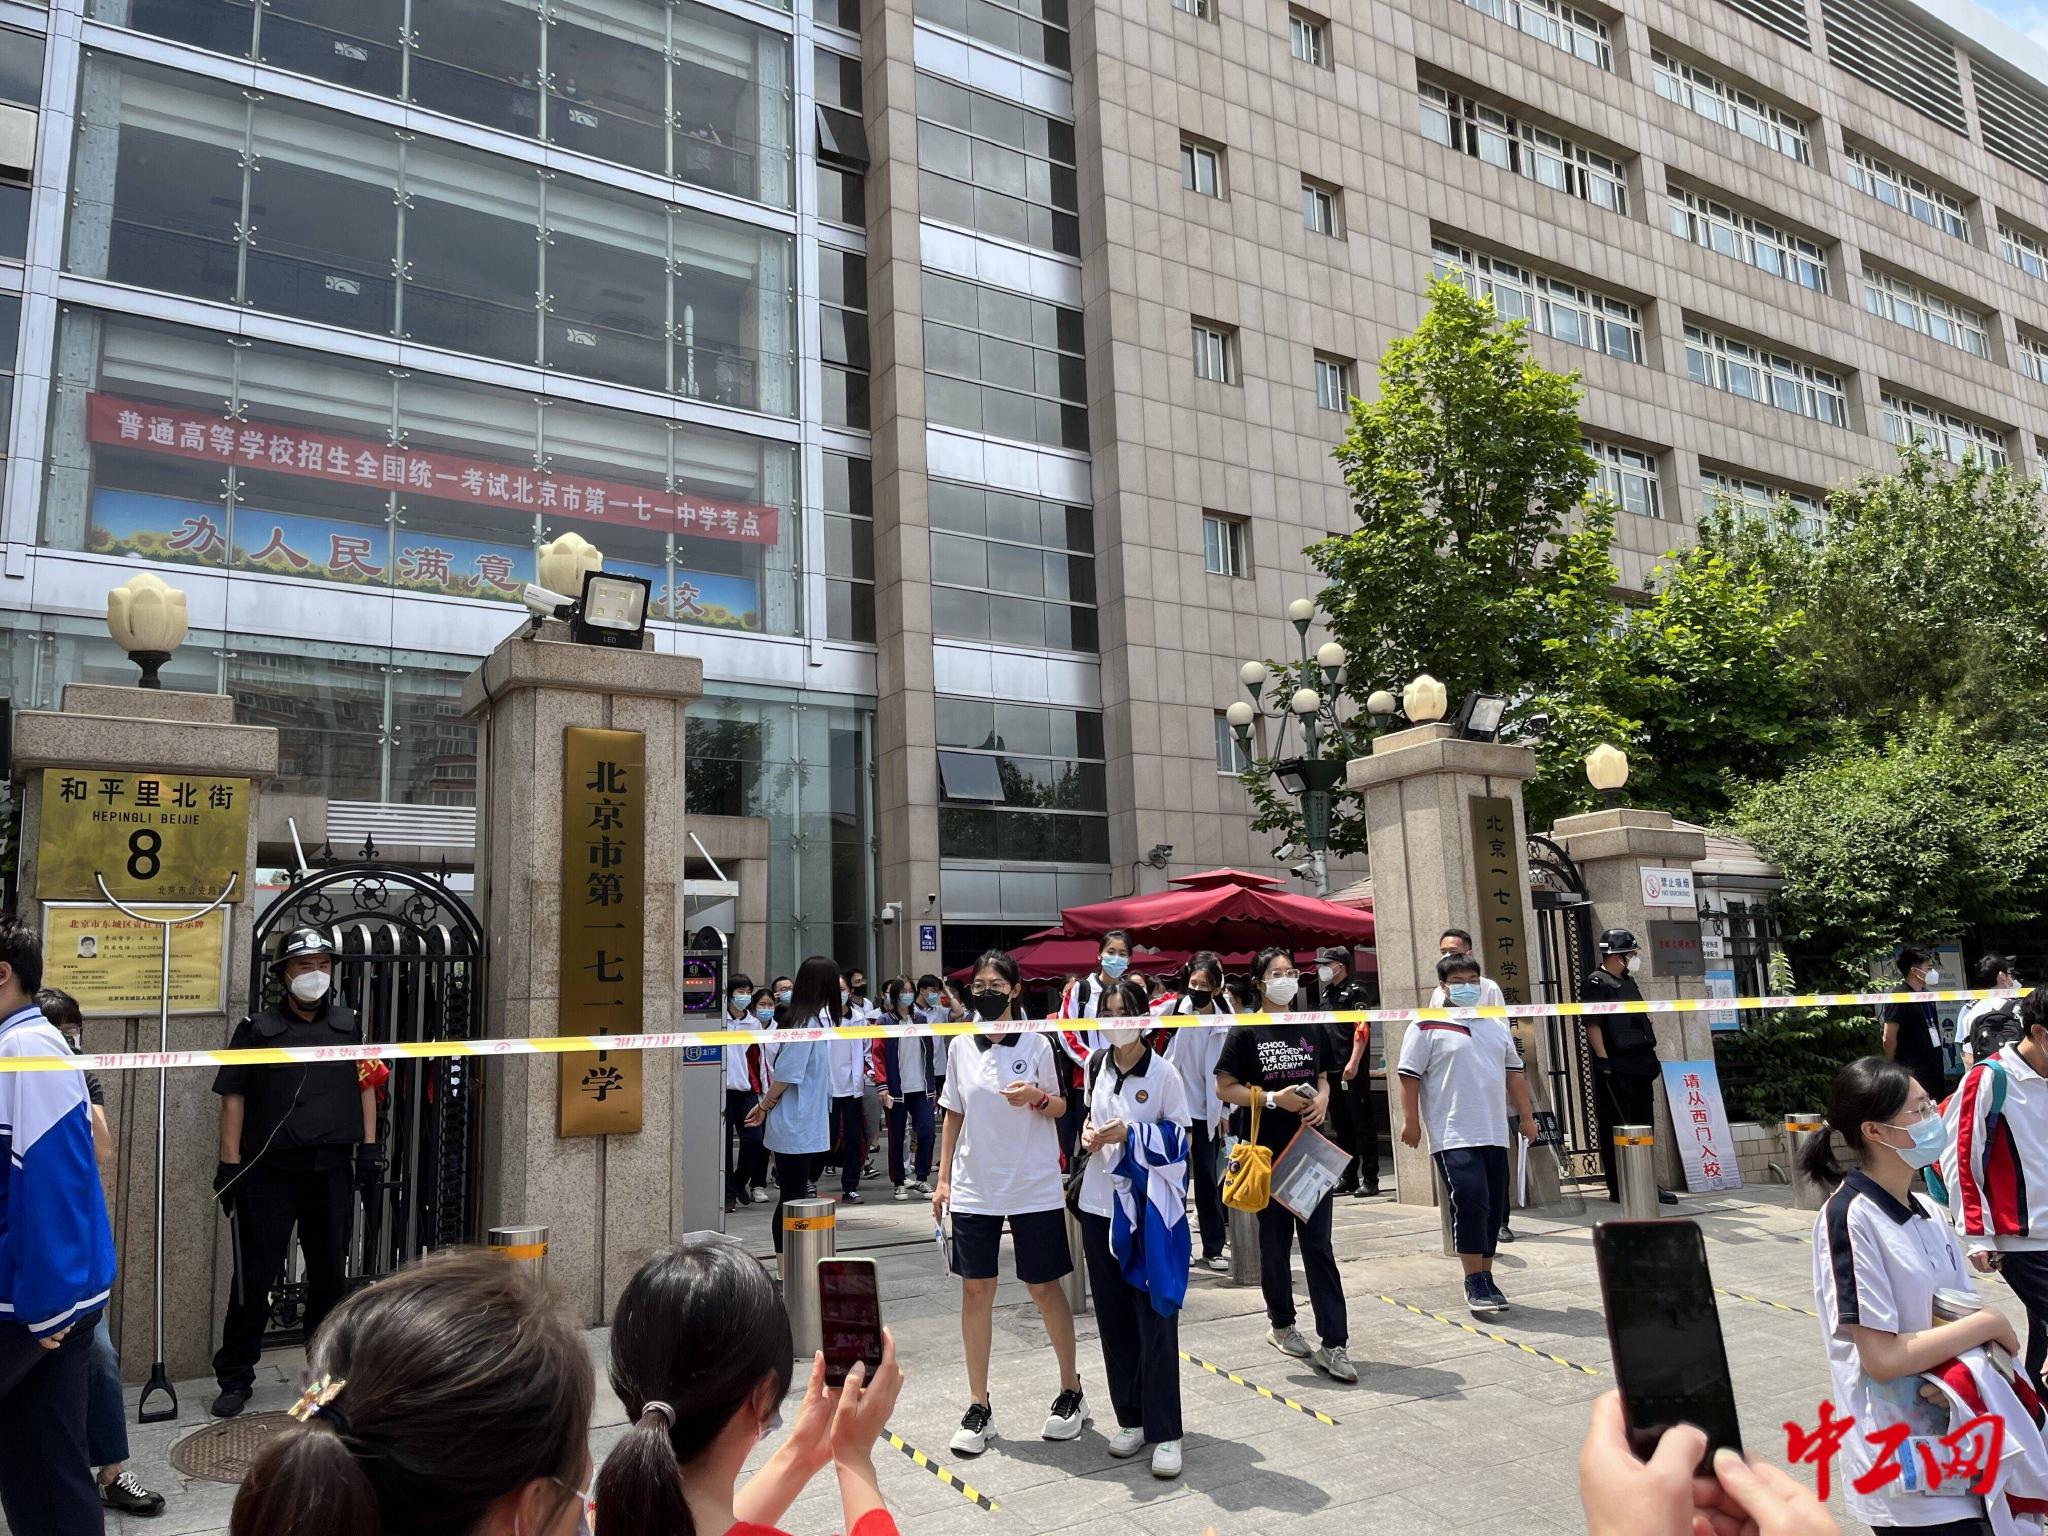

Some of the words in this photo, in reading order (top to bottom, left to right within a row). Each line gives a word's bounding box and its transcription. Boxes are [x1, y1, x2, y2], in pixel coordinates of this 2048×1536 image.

[117, 409, 761, 537] 普通高等学校招生全国统一考试北京市第一七一中学考点
[166, 515, 705, 617] 办人民满意校
[602, 635, 617, 644] LED
[60, 776, 234, 810] 和平里北街
[92, 811, 151, 824] HEPINGLI
[160, 813, 200, 825] BEIJIE
[127, 829, 162, 880] 8
[581, 760, 628, 1102] 北京市第一七一学
[1257, 1041, 1288, 1051] SCHOOL
[1258, 1048, 1299, 1057] ATTACHED
[1259, 1055, 1277, 1065] THE
[1279, 1053, 1313, 1062] CENTRAL
[1261, 1062, 1298, 1072] ACADEMY
[1682, 1072, 1722, 1180] 请从西门入校
